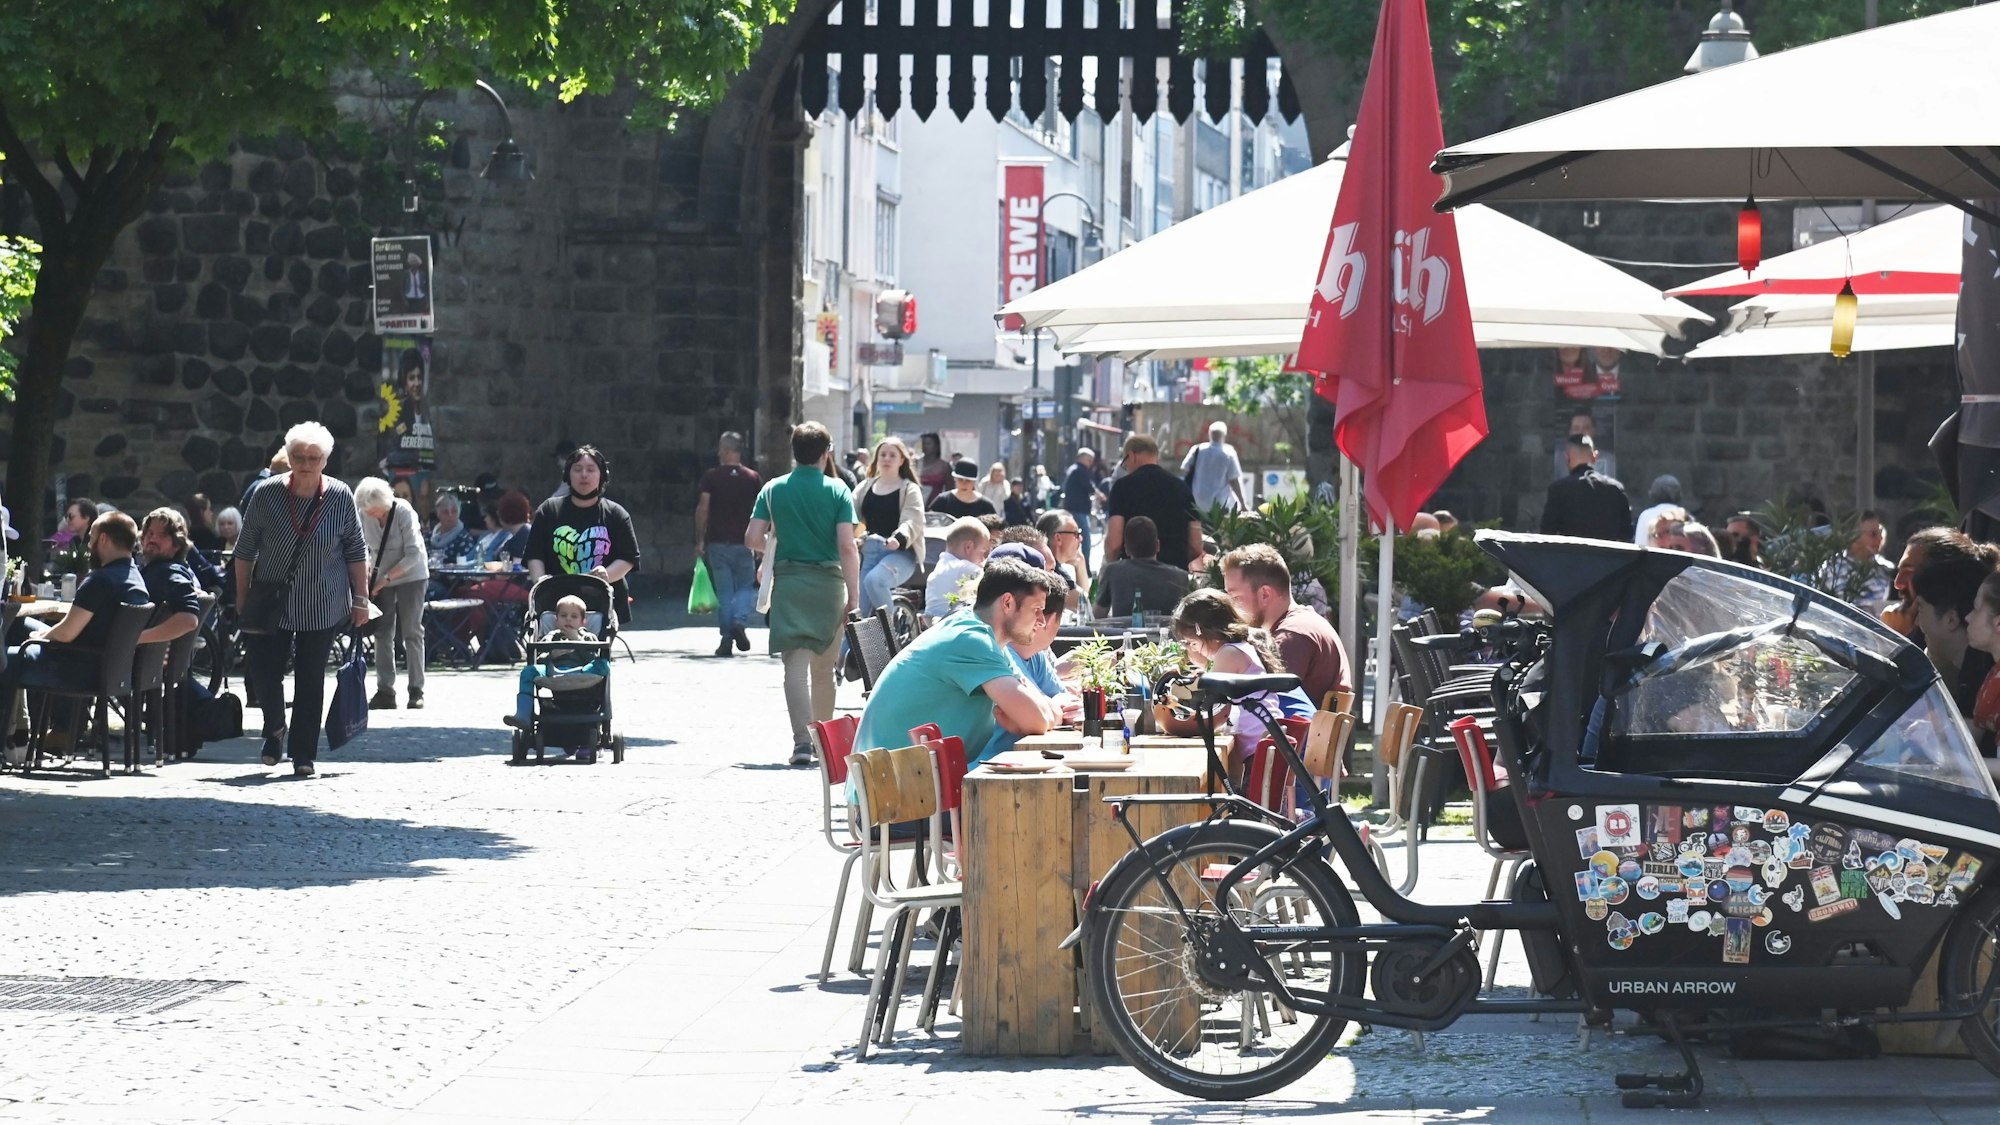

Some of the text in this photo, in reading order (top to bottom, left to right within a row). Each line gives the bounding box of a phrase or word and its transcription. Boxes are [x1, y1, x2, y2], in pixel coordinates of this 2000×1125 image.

[1009, 196, 1039, 300] REWE
[386, 319, 417, 328] PARTEI
[1645, 863, 1679, 875] BERLIN
[1810, 901, 1856, 918] BROADWAY
[1609, 981, 1736, 994] URBAN ARROW
